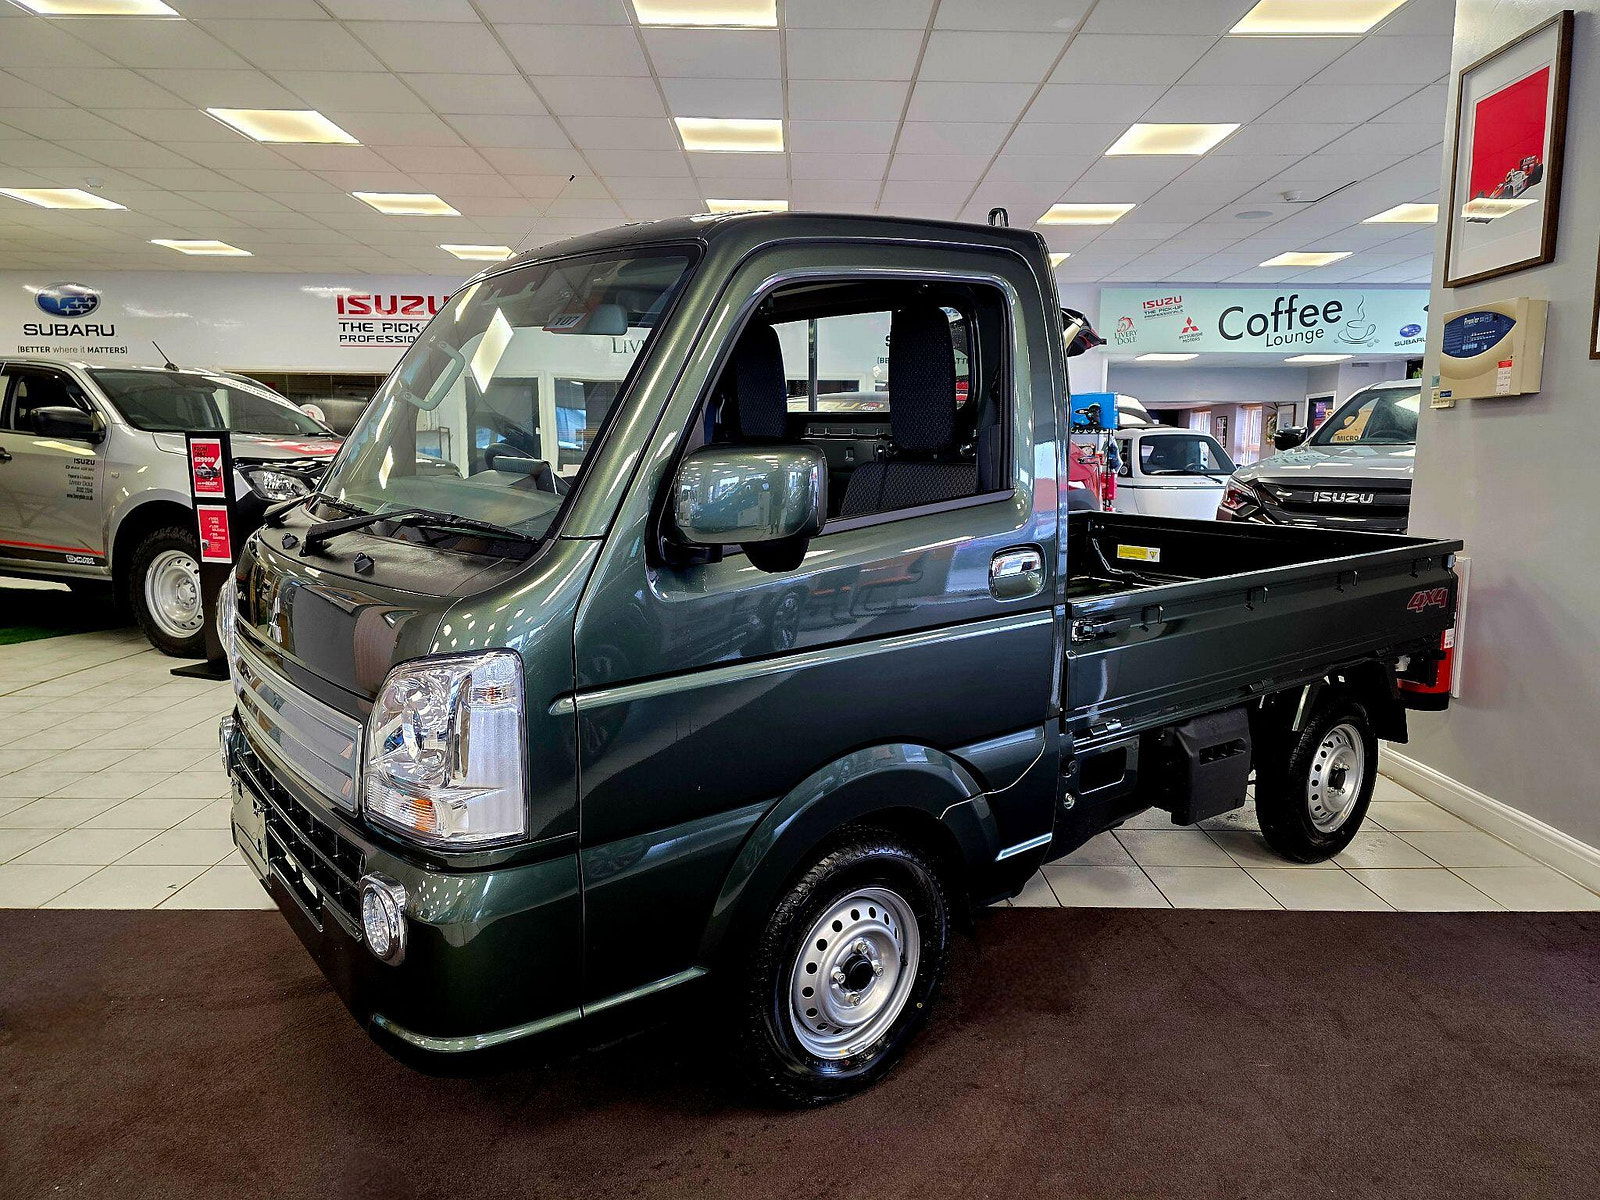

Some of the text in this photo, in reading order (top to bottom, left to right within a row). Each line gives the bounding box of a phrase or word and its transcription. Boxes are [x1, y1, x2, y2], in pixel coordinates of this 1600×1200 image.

[1142, 296, 1182, 309] ISUZU
[1218, 294, 1343, 340] Coffee
[23, 323, 115, 337] SUBARU
[339, 322, 374, 333] THE
[1266, 328, 1325, 347] Lounge
[53, 345, 78, 353] where
[80, 345, 86, 353] it
[612, 337, 645, 354] LIV
[74, 458, 96, 466] ISUZU
[1313, 491, 1374, 504] ISUZU
